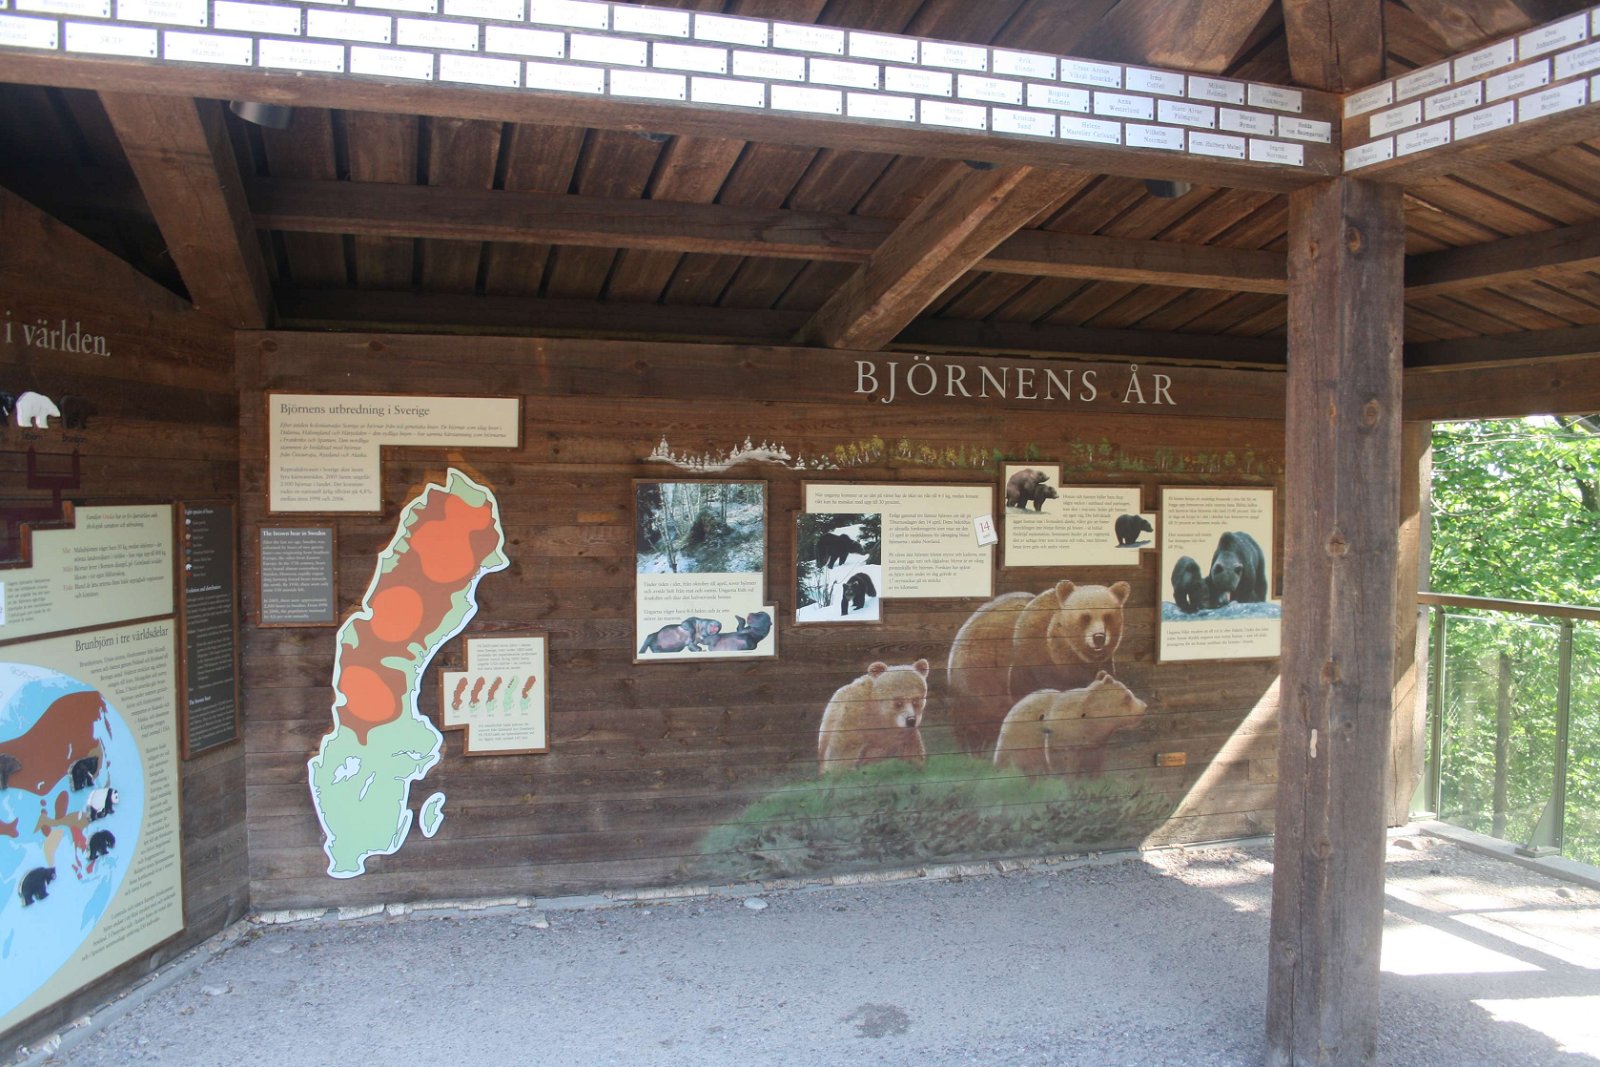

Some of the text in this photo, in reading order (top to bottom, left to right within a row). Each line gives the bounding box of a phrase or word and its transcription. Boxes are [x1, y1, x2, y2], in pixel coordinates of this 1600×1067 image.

[5, 310, 112, 357] i världen.
[854, 355, 1177, 405] BJÖRNENS ÅR
[279, 403, 326, 416] Björnens
[329, 404, 385, 417] utbredning
[394, 405, 430, 418] Sverige
[980, 520, 991, 532] 14
[75, 637, 114, 652] Brunbjörn
[120, 634, 131, 645] tre
[132, 625, 169, 642] världsdelar
